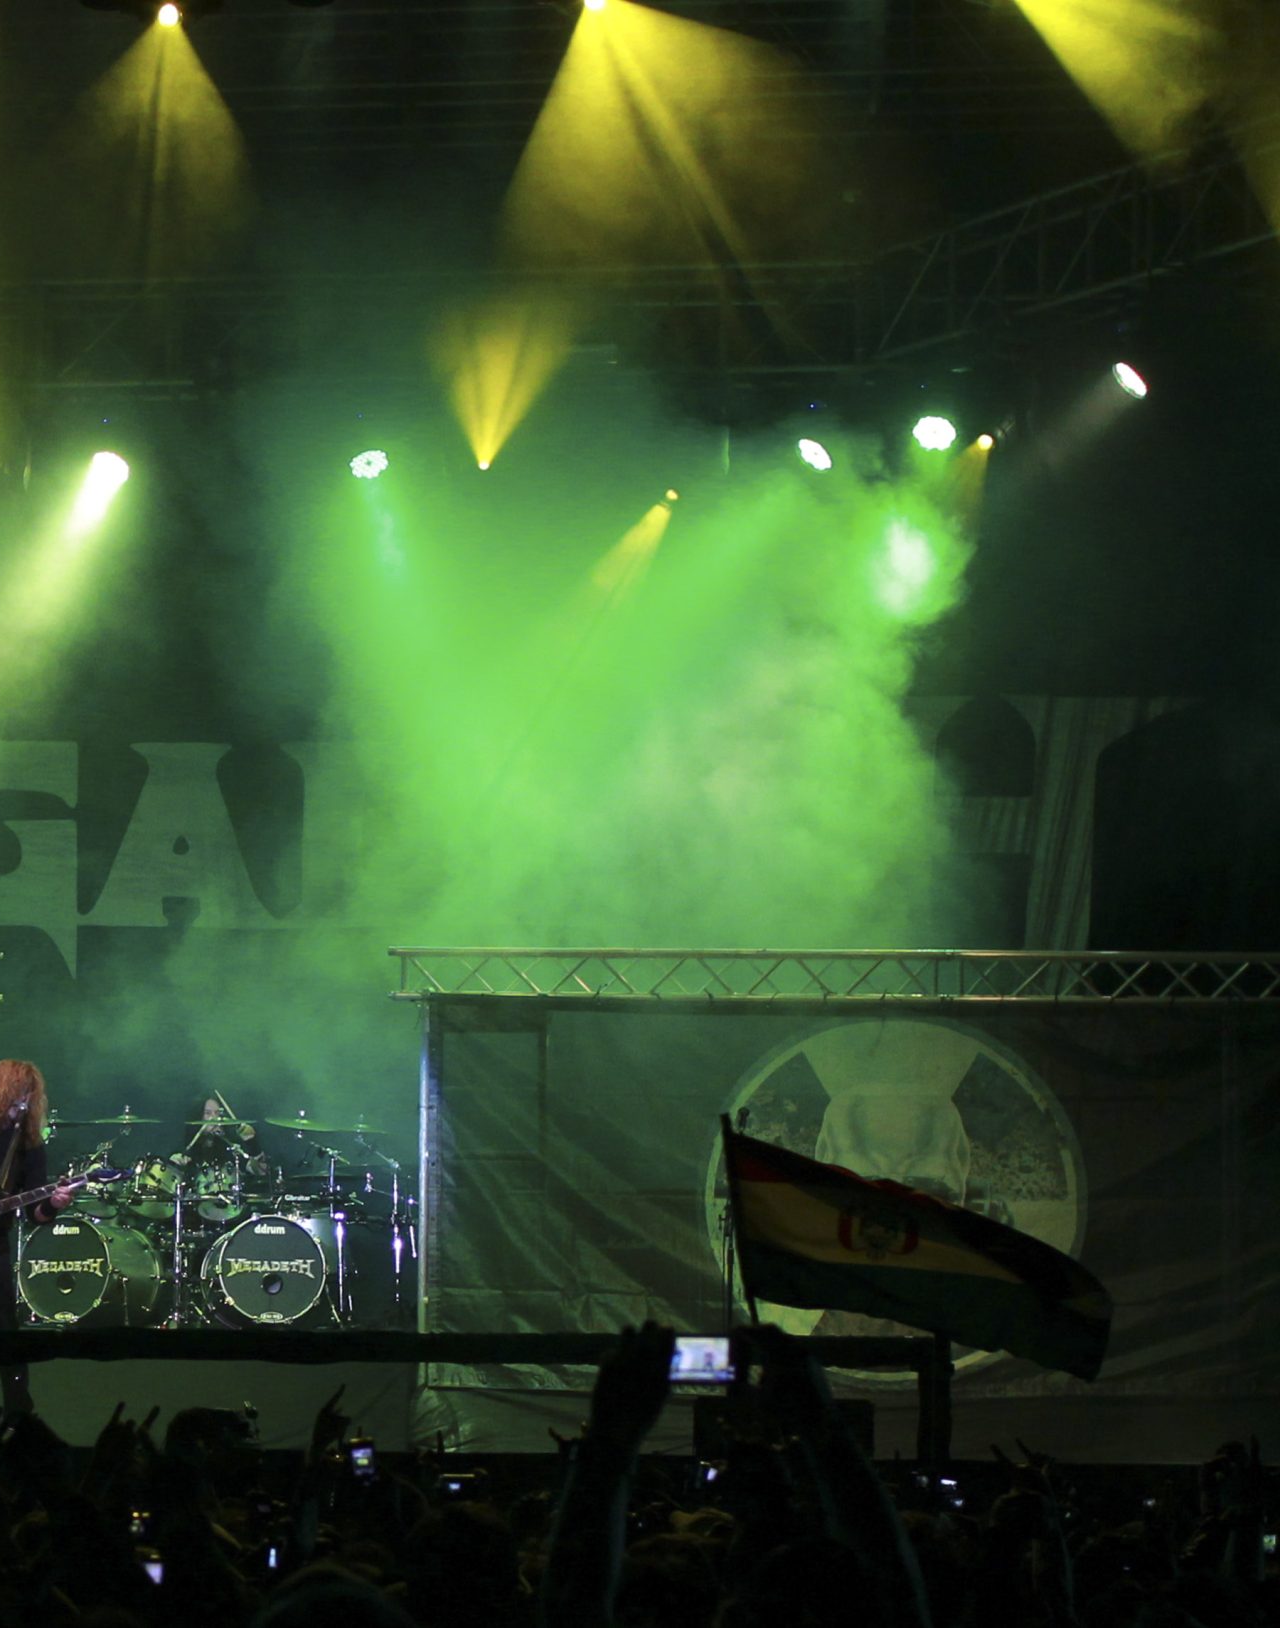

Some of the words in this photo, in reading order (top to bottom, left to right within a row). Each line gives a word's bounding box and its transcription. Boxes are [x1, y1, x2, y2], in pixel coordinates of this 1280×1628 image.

[52, 1224, 81, 1236] ddrum
[254, 1224, 286, 1236] ddrum
[27, 1258, 105, 1279] MEGADETH
[225, 1258, 316, 1279] MEGADETH
